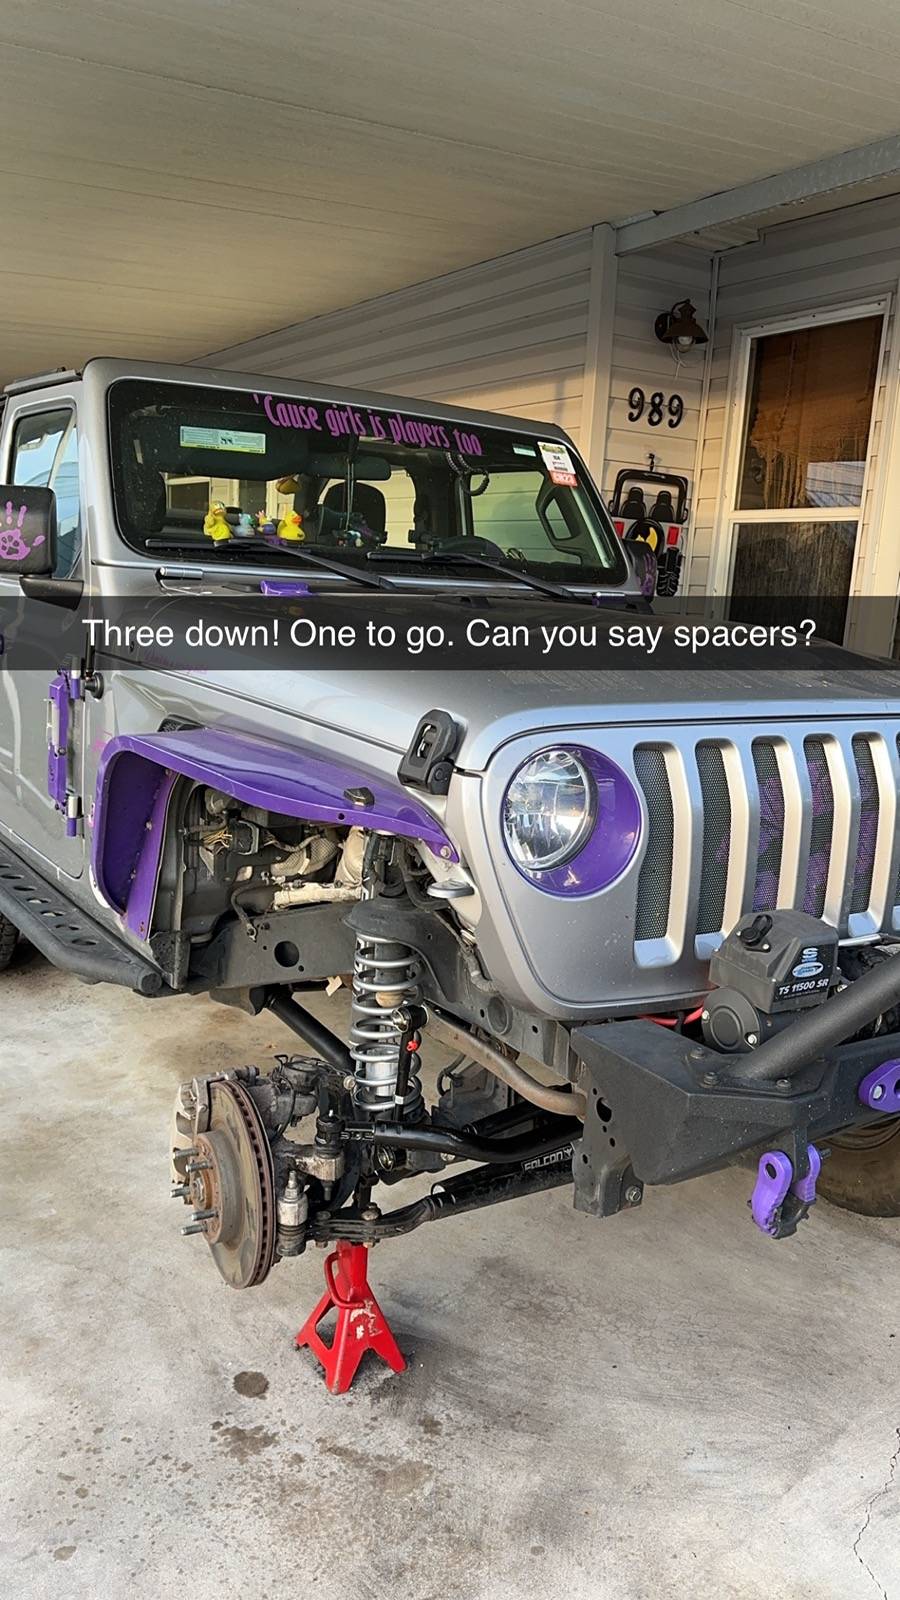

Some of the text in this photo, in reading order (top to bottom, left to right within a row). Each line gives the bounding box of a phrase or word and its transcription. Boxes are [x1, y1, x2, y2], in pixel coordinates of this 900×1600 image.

[628, 387, 683, 428] 989
[325, 404, 367, 437] girls
[367, 409, 386, 439] is
[388, 414, 450, 448] players
[453, 428, 482, 456] too
[779, 985, 791, 995] TS
[792, 981, 816, 992] 11500
[816, 978, 829, 988] SR
[524, 1151, 563, 1171] FALCON
